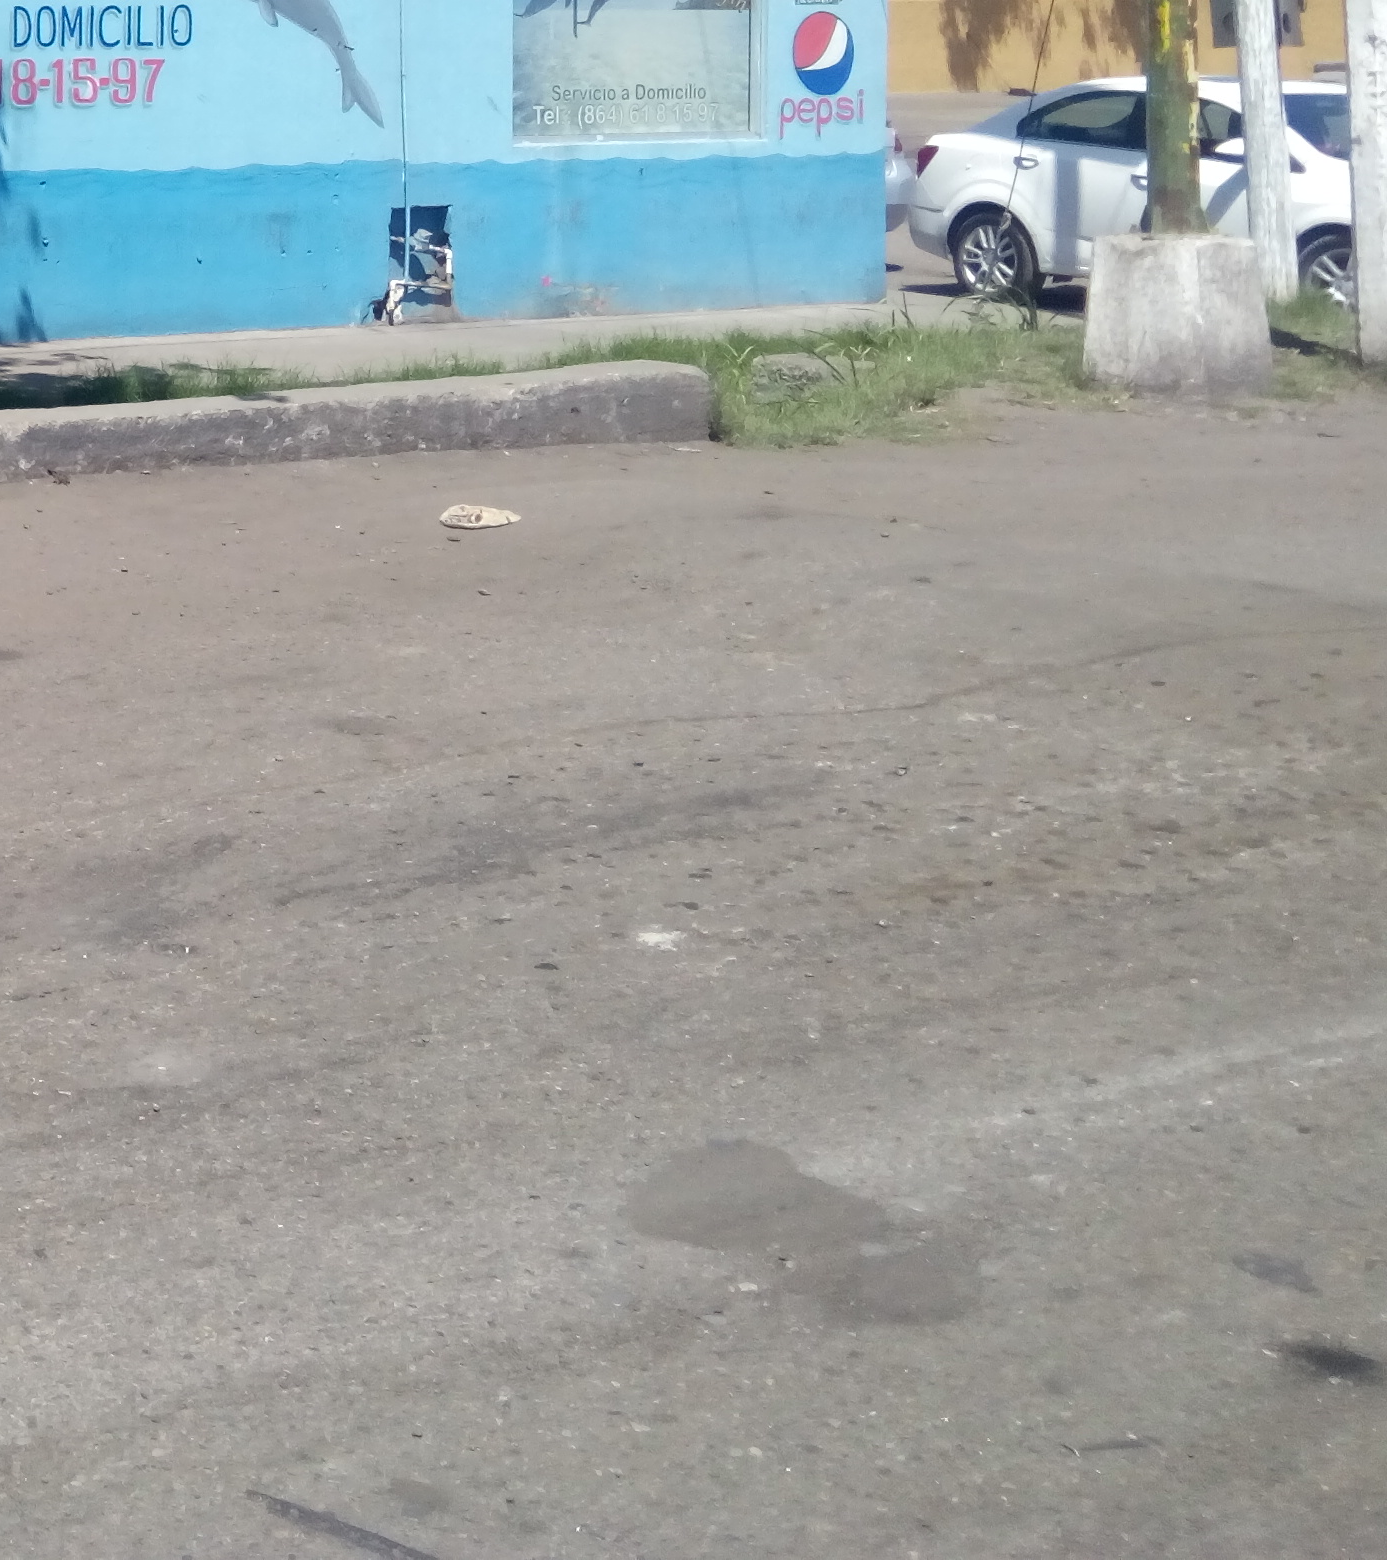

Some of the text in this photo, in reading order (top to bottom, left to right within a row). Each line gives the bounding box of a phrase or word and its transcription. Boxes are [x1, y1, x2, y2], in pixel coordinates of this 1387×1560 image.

[12, 3, 194, 49] DOMICILIO
[552, 83, 708, 102] Servicio a Domicilio
[577, 104, 624, 130] (864)
[778, 88, 865, 141] pepsi
